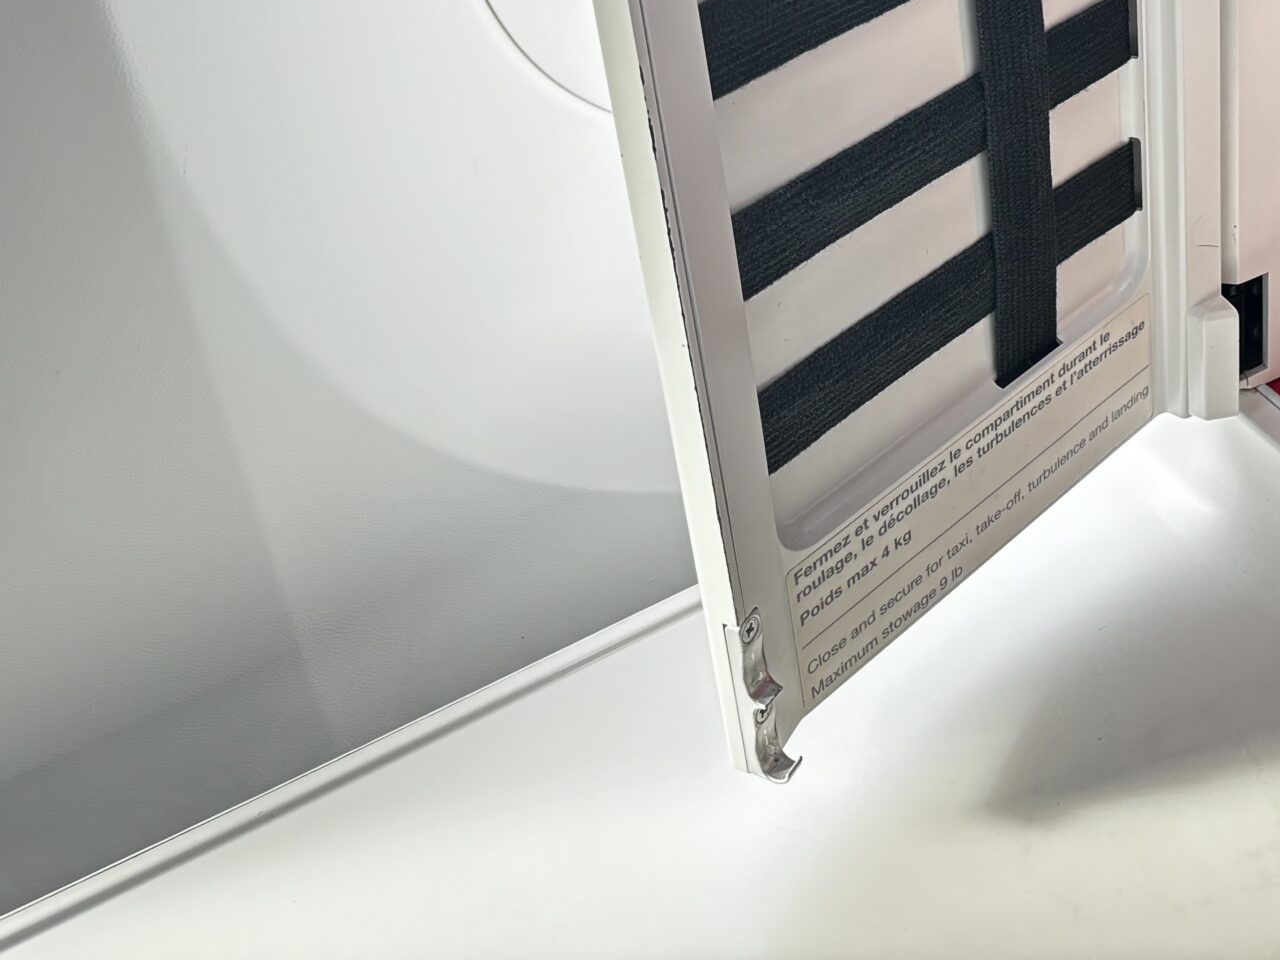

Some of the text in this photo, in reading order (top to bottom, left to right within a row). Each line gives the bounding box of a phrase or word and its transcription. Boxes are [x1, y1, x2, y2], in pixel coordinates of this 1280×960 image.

[794, 331, 1110, 585] Fermez et verrouillez le compartiment durant le
[797, 319, 1145, 603] roulage, le décollage, les turbulences et l'atterrissage
[800, 529, 912, 627] Poids max 4 kg
[807, 385, 1149, 674] Close and secure for taxi, take-off, turbulence and landing
[811, 565, 964, 699] Maximum stowage 9 lb
